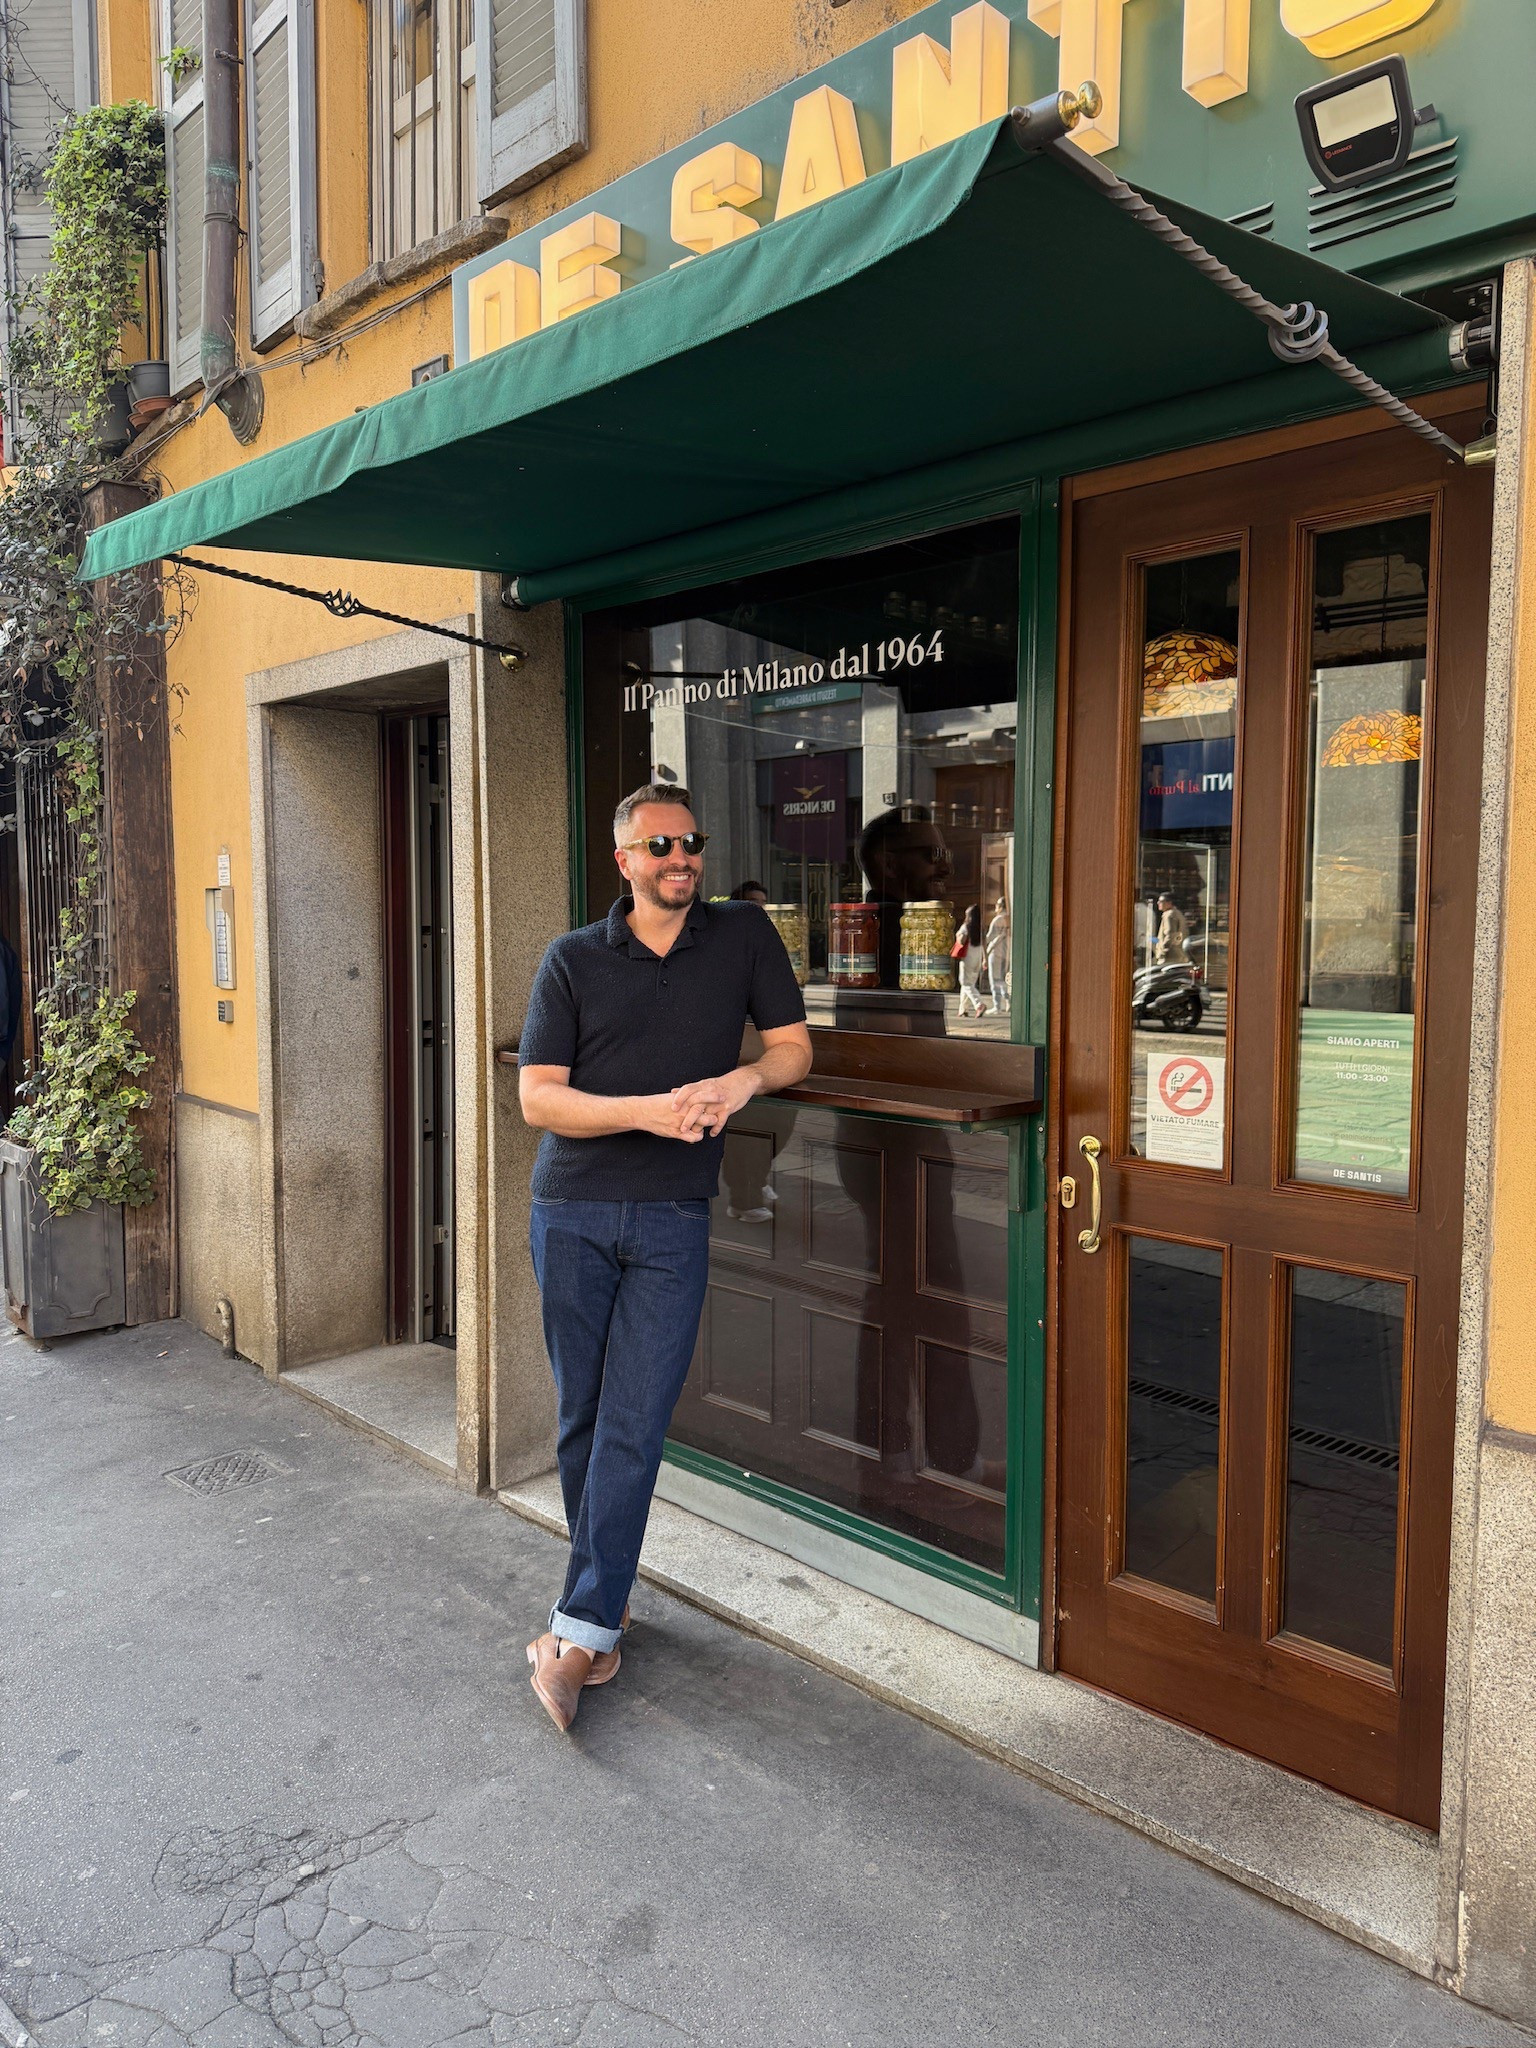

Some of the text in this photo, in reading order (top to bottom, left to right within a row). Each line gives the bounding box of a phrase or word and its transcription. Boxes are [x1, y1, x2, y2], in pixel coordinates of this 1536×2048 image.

[623, 629, 945, 712] Il Panino di Milano dal 1964
[1326, 1035, 1400, 1049] SIAMO APERTI
[1335, 1061, 1357, 1071] TUTTI
[1361, 1064, 1390, 1073] GIORNI
[1335, 1071, 1358, 1080] 11:00
[1363, 1073, 1388, 1082] 23:00
[1150, 1114, 1220, 1129] VIETATO FUMARE
[1333, 1168, 1382, 1183] DE SANTIS
